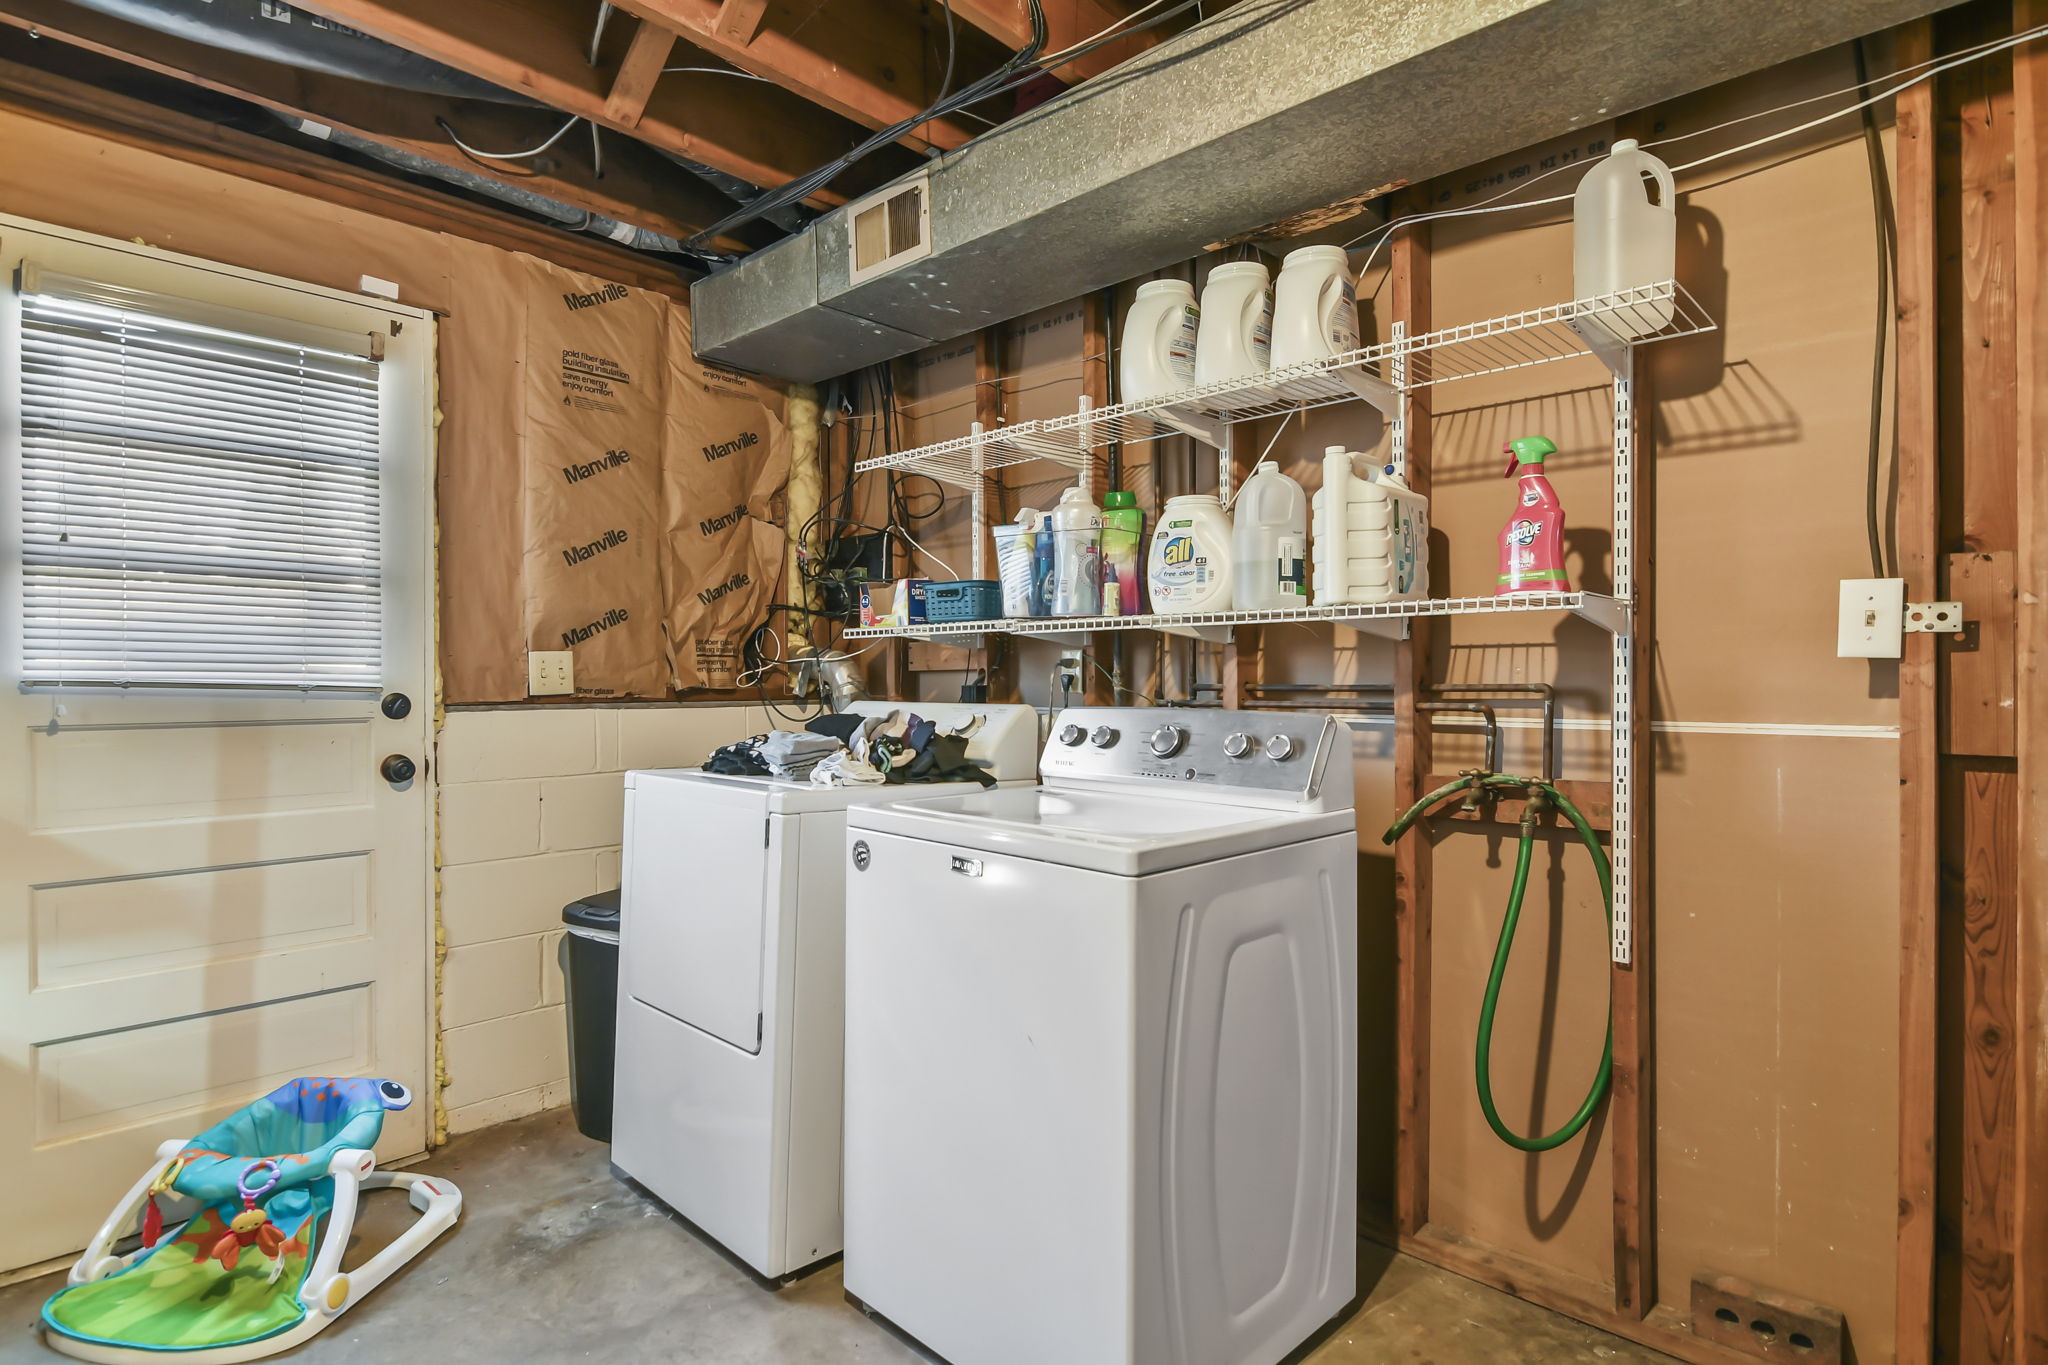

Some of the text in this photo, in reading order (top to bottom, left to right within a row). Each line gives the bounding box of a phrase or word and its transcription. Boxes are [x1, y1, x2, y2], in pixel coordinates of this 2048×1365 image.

[562, 283, 629, 312] Manville
[562, 349, 619, 369] gold fiber glass
[562, 356, 630, 380] building insulation
[562, 372, 608, 389] save energy
[562, 380, 614, 397] enjoy comfort
[702, 371, 721, 381] enjoy
[702, 431, 759, 462] Manville
[562, 448, 631, 485] Manville
[700, 503, 750, 537] Manville
[561, 528, 628, 567] Manville
[1165, 537, 1192, 566] all
[697, 572, 750, 606] Manville
[561, 608, 629, 649] Manville
